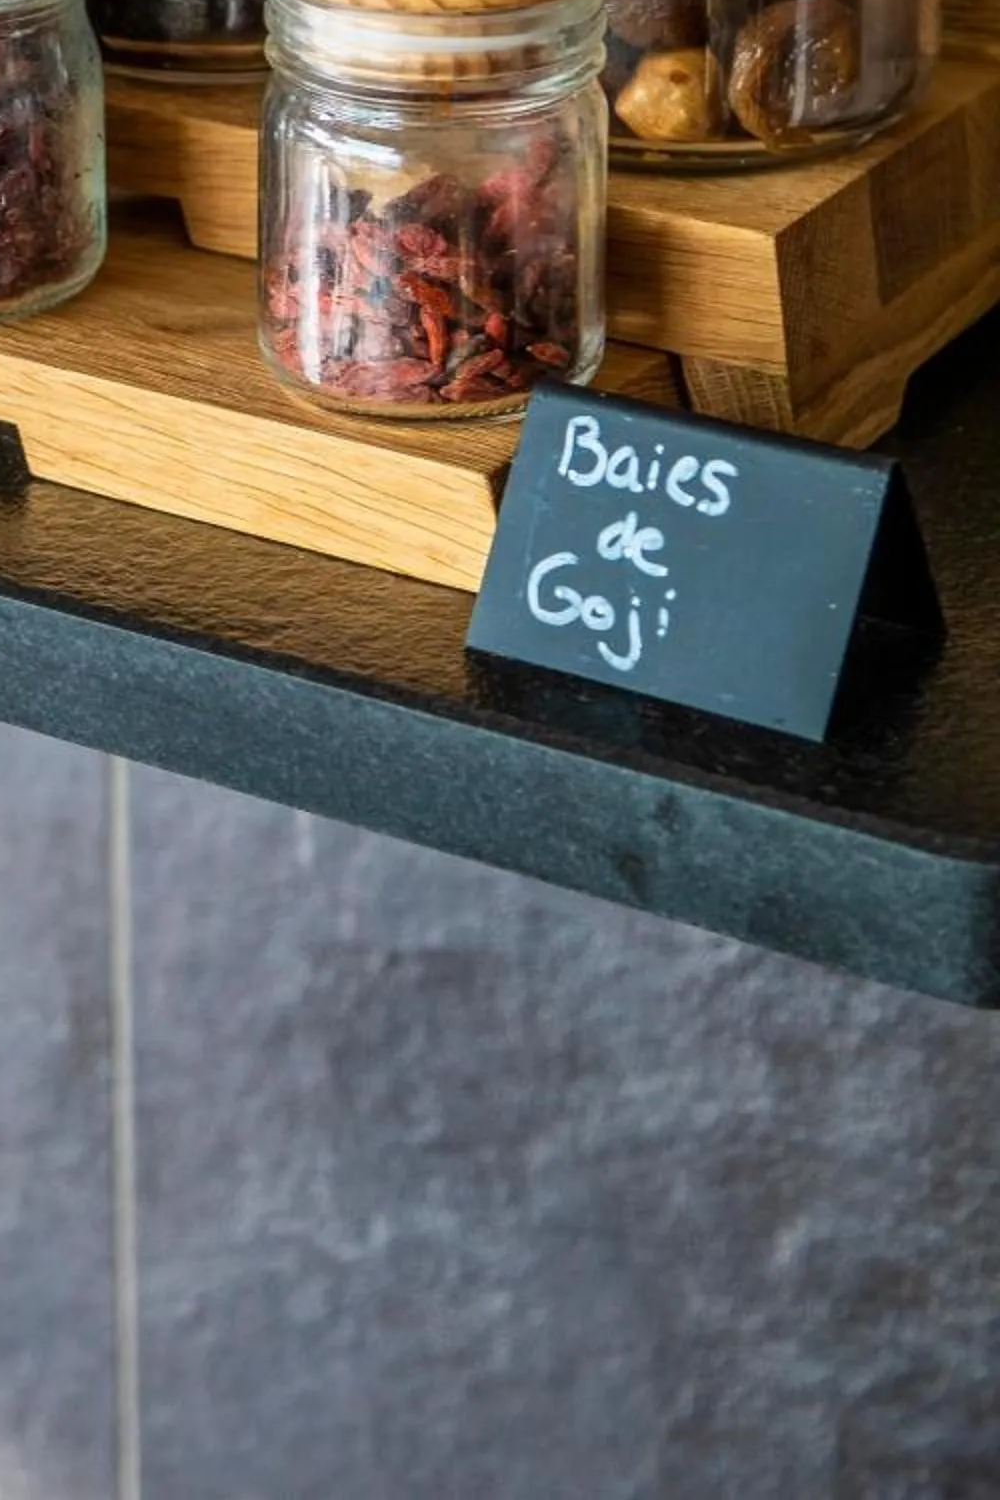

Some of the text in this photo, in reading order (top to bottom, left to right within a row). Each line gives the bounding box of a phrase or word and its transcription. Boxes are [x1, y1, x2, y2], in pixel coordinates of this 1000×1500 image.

[556, 414, 738, 517] Baies
[597, 510, 669, 577] de
[527, 551, 677, 671] Goji
